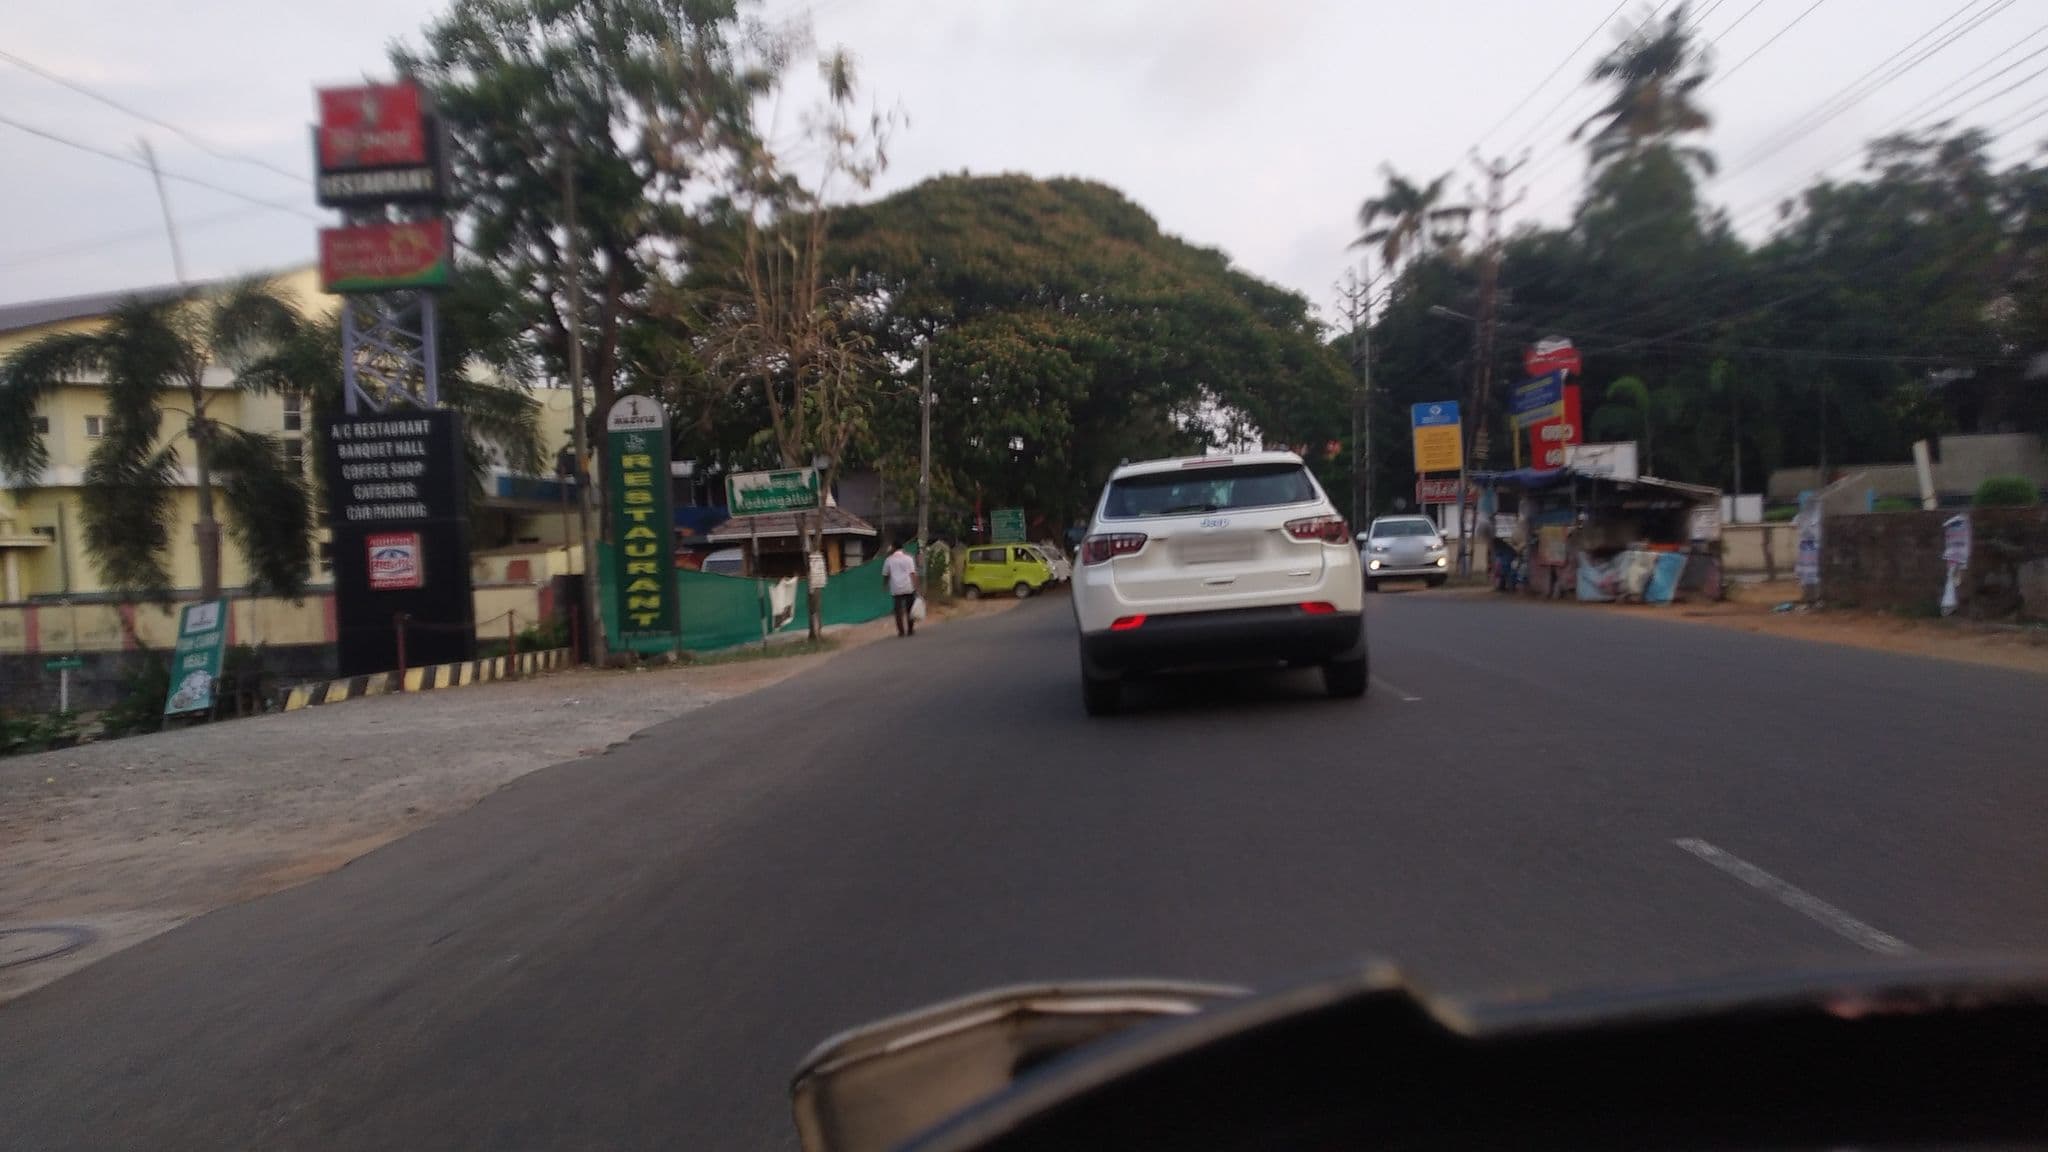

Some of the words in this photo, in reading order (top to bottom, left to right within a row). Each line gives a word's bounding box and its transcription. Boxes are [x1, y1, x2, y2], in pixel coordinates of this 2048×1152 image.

[353, 420, 430, 437] RESTAURANT
[338, 442, 392, 459] BANQUET
[394, 440, 424, 456] HALL
[342, 463, 388, 479] COFFEE
[390, 461, 424, 477] SHOP
[622, 454, 661, 627] RESTAURANT
